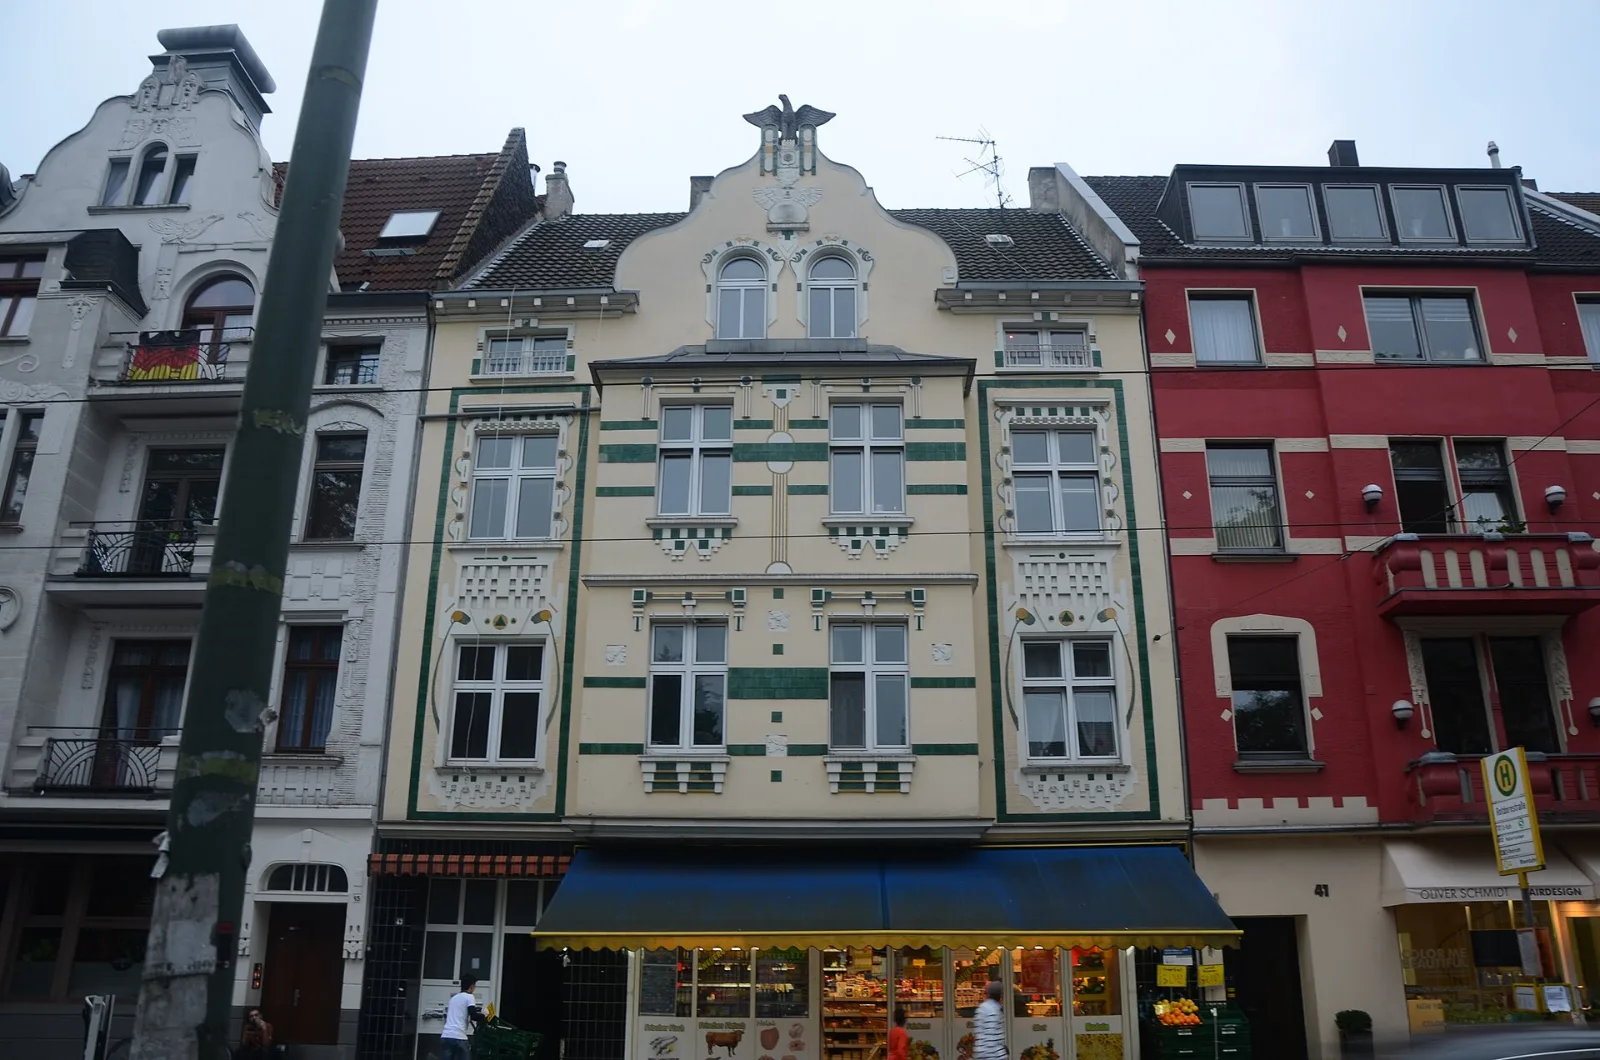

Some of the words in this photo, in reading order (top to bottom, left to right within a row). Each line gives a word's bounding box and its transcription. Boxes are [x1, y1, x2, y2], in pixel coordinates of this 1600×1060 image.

[1500, 763, 1512, 787] H
[1314, 884, 1330, 897] 41
[1420, 888, 1458, 900] OLIVER
[1460, 887, 1509, 899] SCHMIDT
[1529, 887, 1582, 897] AIRDESIGN
